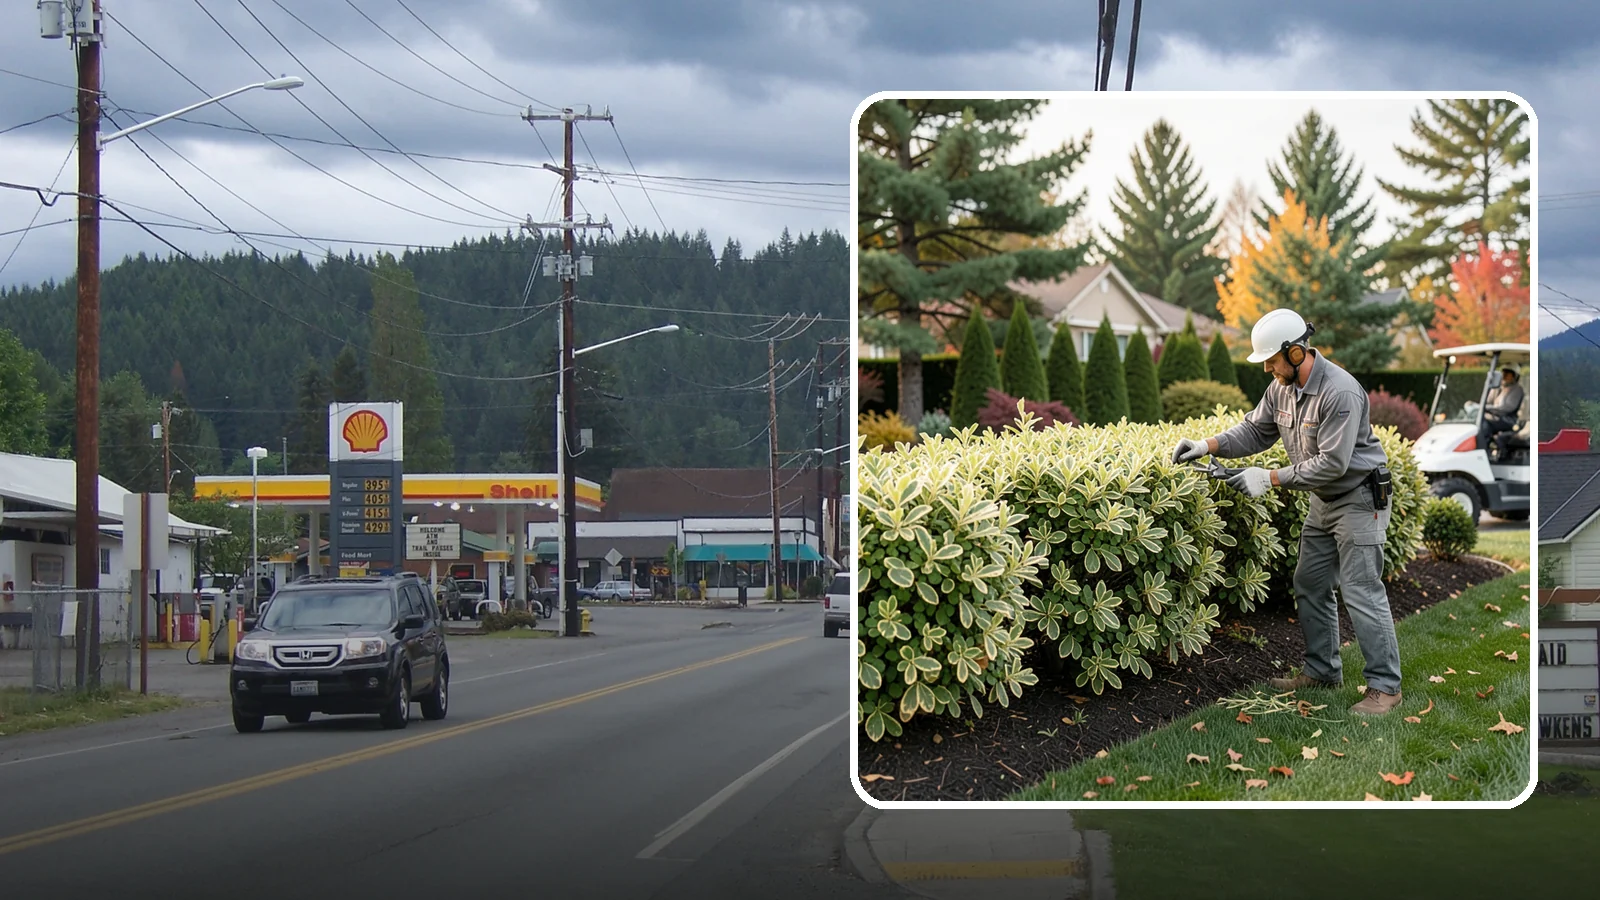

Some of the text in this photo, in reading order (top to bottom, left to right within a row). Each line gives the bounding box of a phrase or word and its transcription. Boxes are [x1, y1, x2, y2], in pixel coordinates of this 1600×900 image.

[366, 480, 383, 490] 395
[490, 484, 547, 499] Shell
[366, 494, 383, 504] 405
[366, 508, 383, 518] 415
[366, 522, 383, 533] 429
